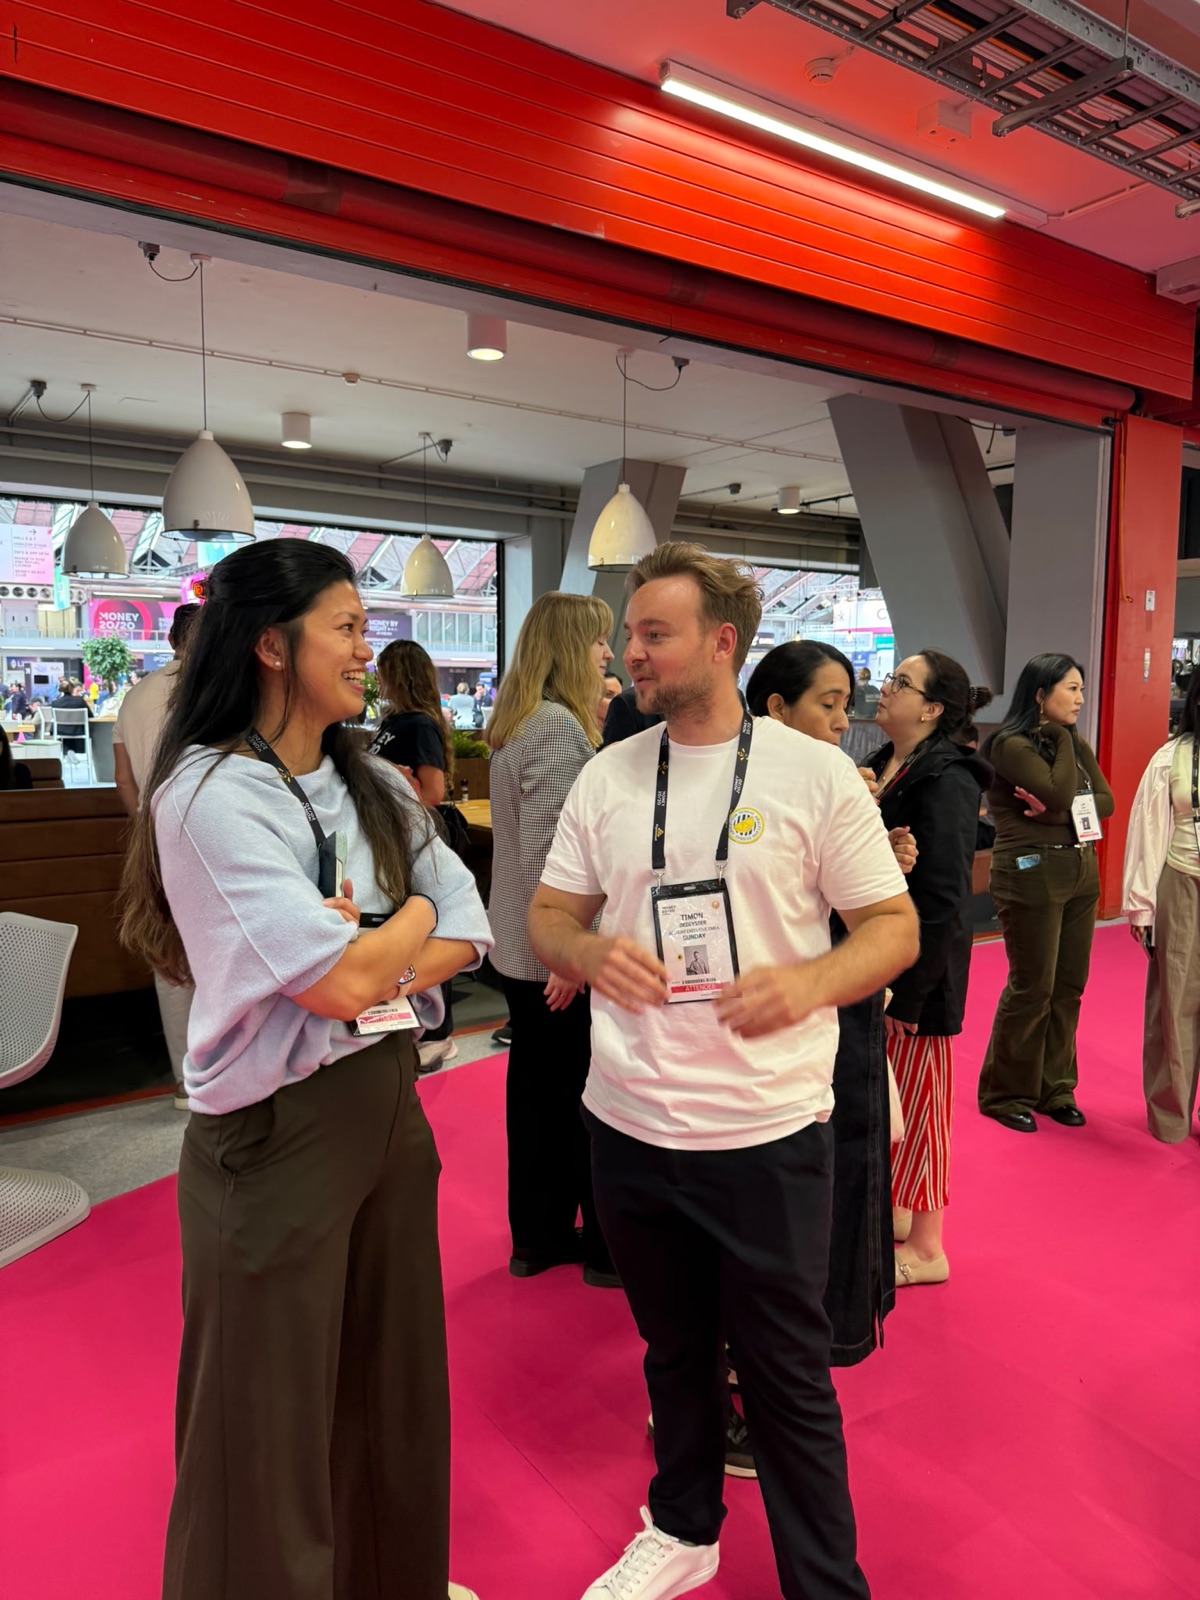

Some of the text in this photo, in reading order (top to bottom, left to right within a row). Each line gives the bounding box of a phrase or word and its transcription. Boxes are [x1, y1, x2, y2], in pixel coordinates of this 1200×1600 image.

[99, 612, 139, 621] MONEY
[99, 621, 135, 630] 20/20
[681, 912, 704, 921] TIMON
